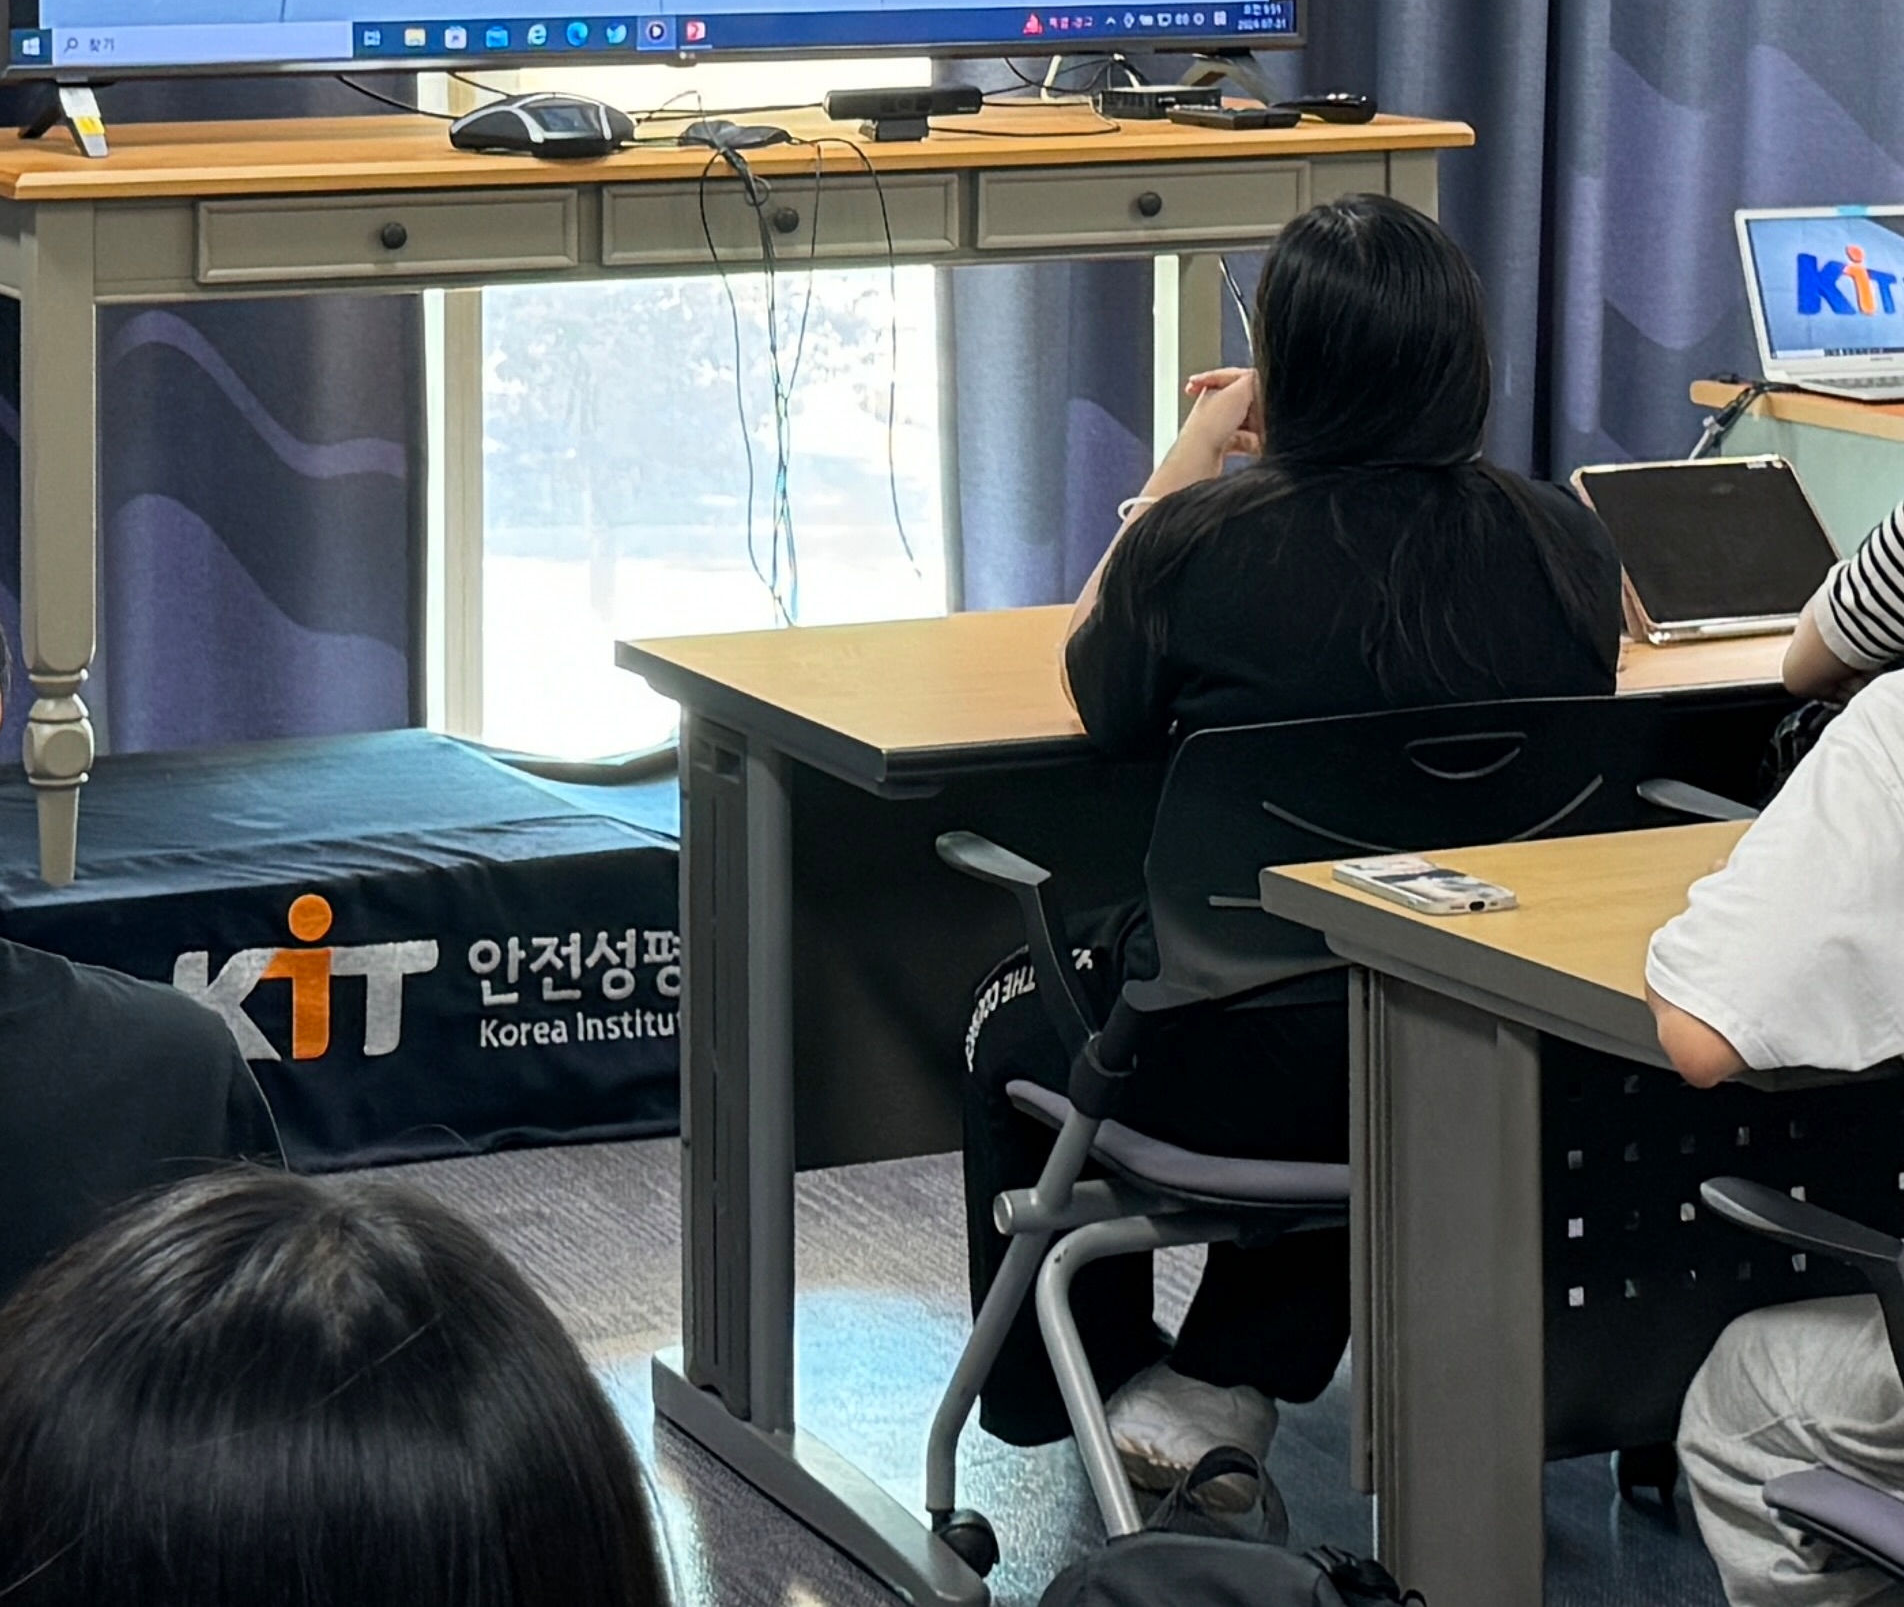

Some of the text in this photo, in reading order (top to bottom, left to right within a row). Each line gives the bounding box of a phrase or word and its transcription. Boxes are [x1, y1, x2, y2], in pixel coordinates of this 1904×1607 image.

[1001, 965, 1036, 1004] THE
[480, 1007, 682, 1048] Korea Institu
